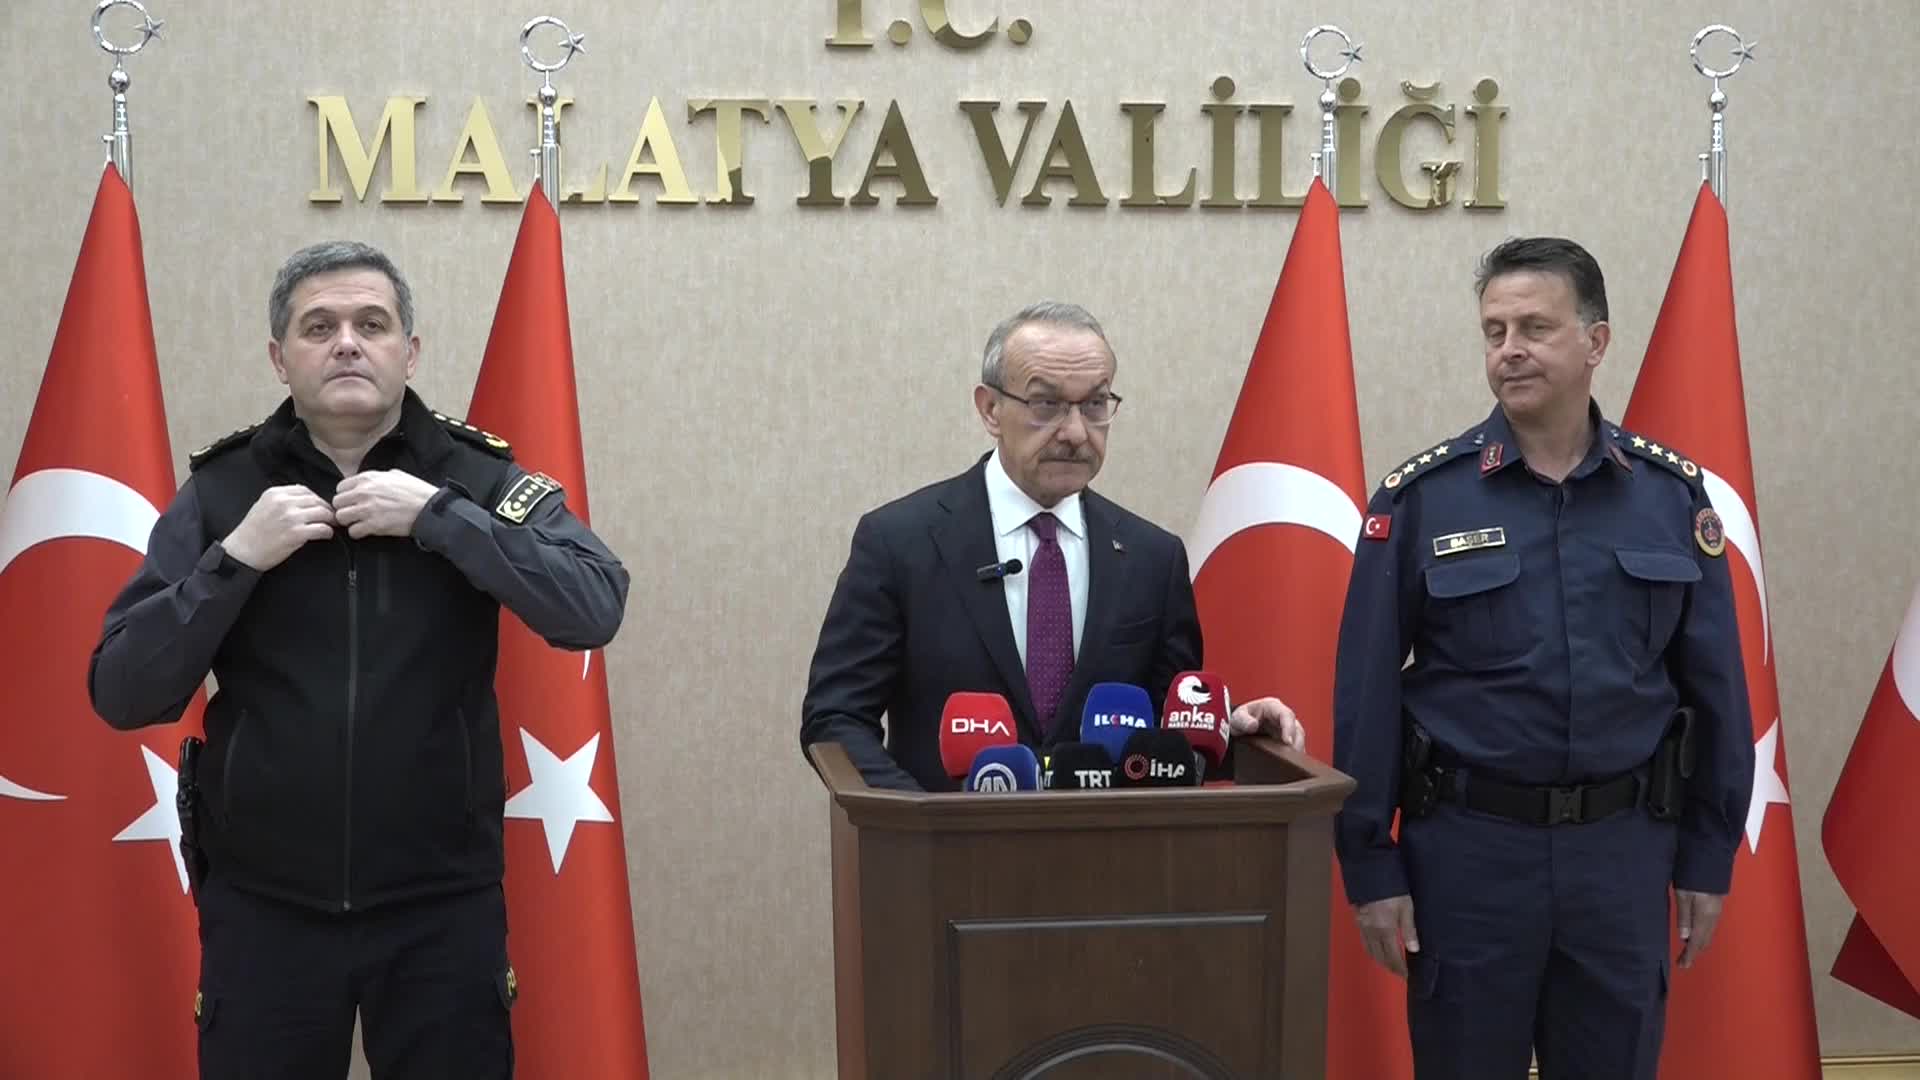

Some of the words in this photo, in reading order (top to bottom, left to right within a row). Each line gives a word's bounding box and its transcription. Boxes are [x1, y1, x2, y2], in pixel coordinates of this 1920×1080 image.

[307, 96, 939, 206] MALATYA
[958, 75, 1508, 210] VALİLİĞİ
[1168, 705, 1215, 724] anka
[951, 718, 1011, 737] DHA
[1150, 758, 1185, 778] İHA
[1074, 770, 1112, 788] TRT
